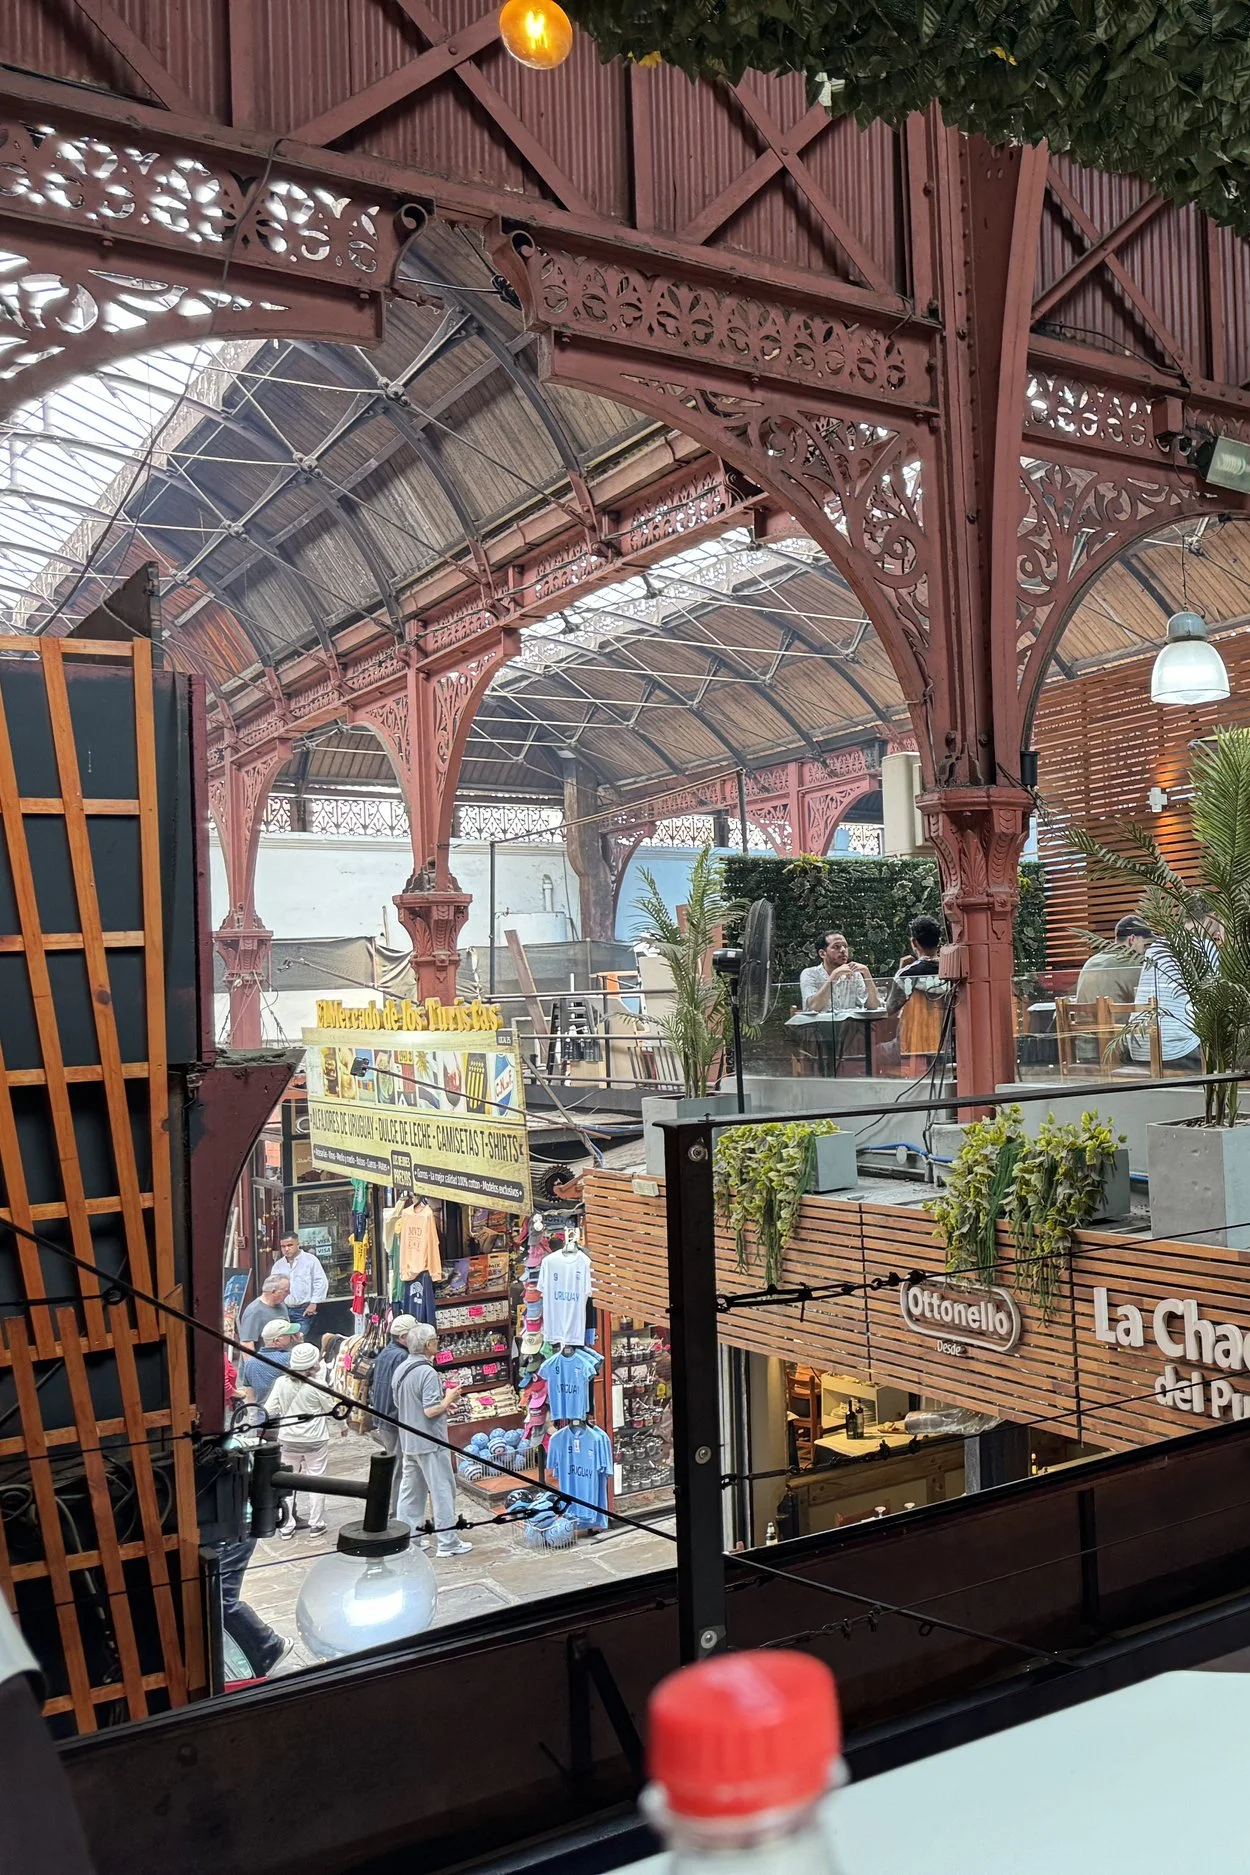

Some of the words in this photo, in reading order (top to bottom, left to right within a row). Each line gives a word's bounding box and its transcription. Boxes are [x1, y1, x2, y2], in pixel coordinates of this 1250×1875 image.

[325, 1000, 382, 1031] Mercado
[383, 998, 400, 1031] de
[402, 998, 428, 1031] los
[425, 997, 504, 1032] Turistas
[312, 1108, 340, 1134] ALFAJORES
[339, 1112, 348, 1136] DE
[348, 1114, 374, 1140] URUGUAY
[378, 1117, 399, 1144] DULCE
[399, 1120, 409, 1146] DE
[409, 1122, 432, 1150] LECHE
[436, 1125, 480, 1157] CAMISETAS
[479, 1130, 519, 1163] T-SHIRTS
[394, 1168, 411, 1187] PRECIOS
[482, 1180, 499, 1193] Modelos
[498, 1183, 519, 1197] exclusivos
[553, 1272, 558, 1282] 9
[554, 1291, 580, 1302] URUGUAY
[908, 1286, 1012, 1335] Ottonello
[1093, 1286, 1144, 1348] La
[936, 1340, 962, 1356] Desde
[1154, 1364, 1205, 1413] del
